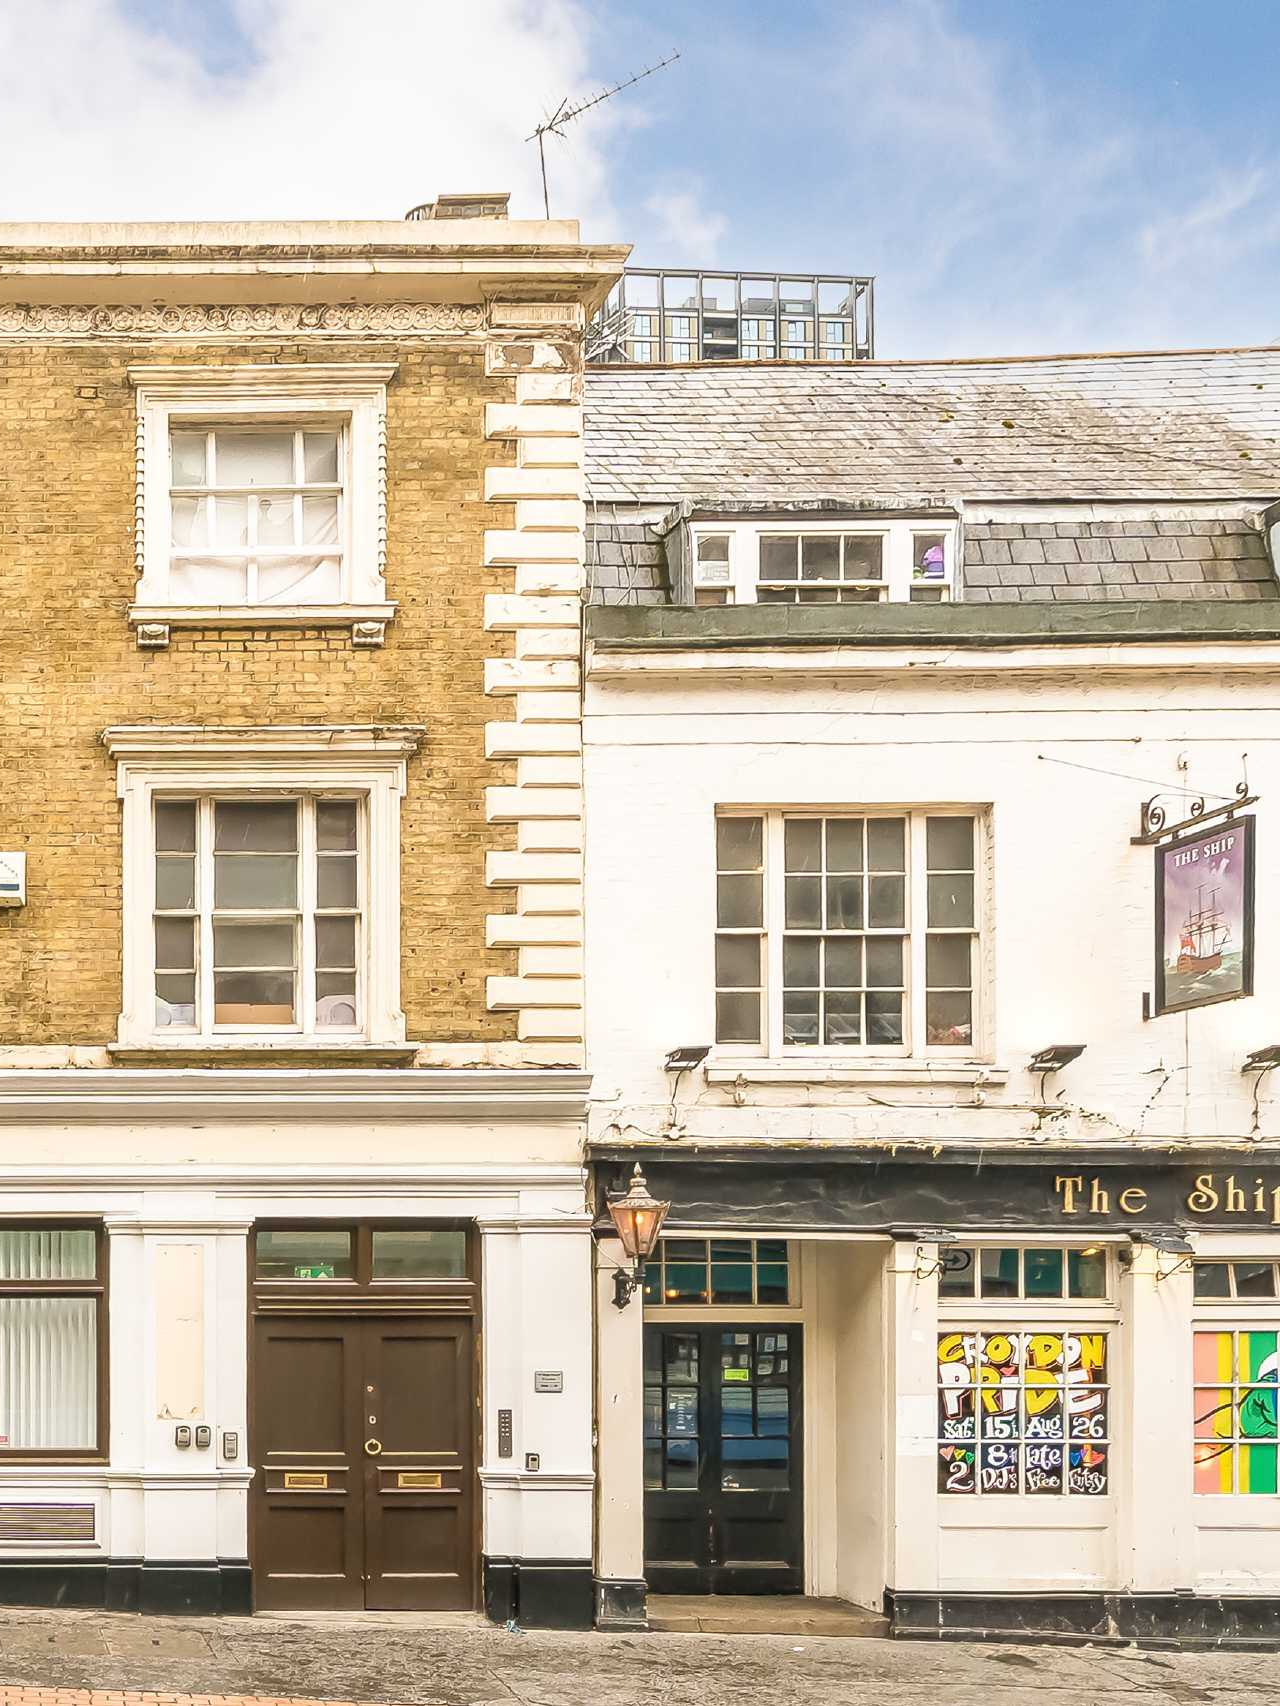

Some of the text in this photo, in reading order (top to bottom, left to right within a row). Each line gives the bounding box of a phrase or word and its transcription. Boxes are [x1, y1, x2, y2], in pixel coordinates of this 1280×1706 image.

[1174, 837, 1235, 867] THE SHIP
[1055, 1175, 1148, 1214] The
[938, 1334, 1106, 1369] CROYDON
[947, 1461, 974, 1491] 2
